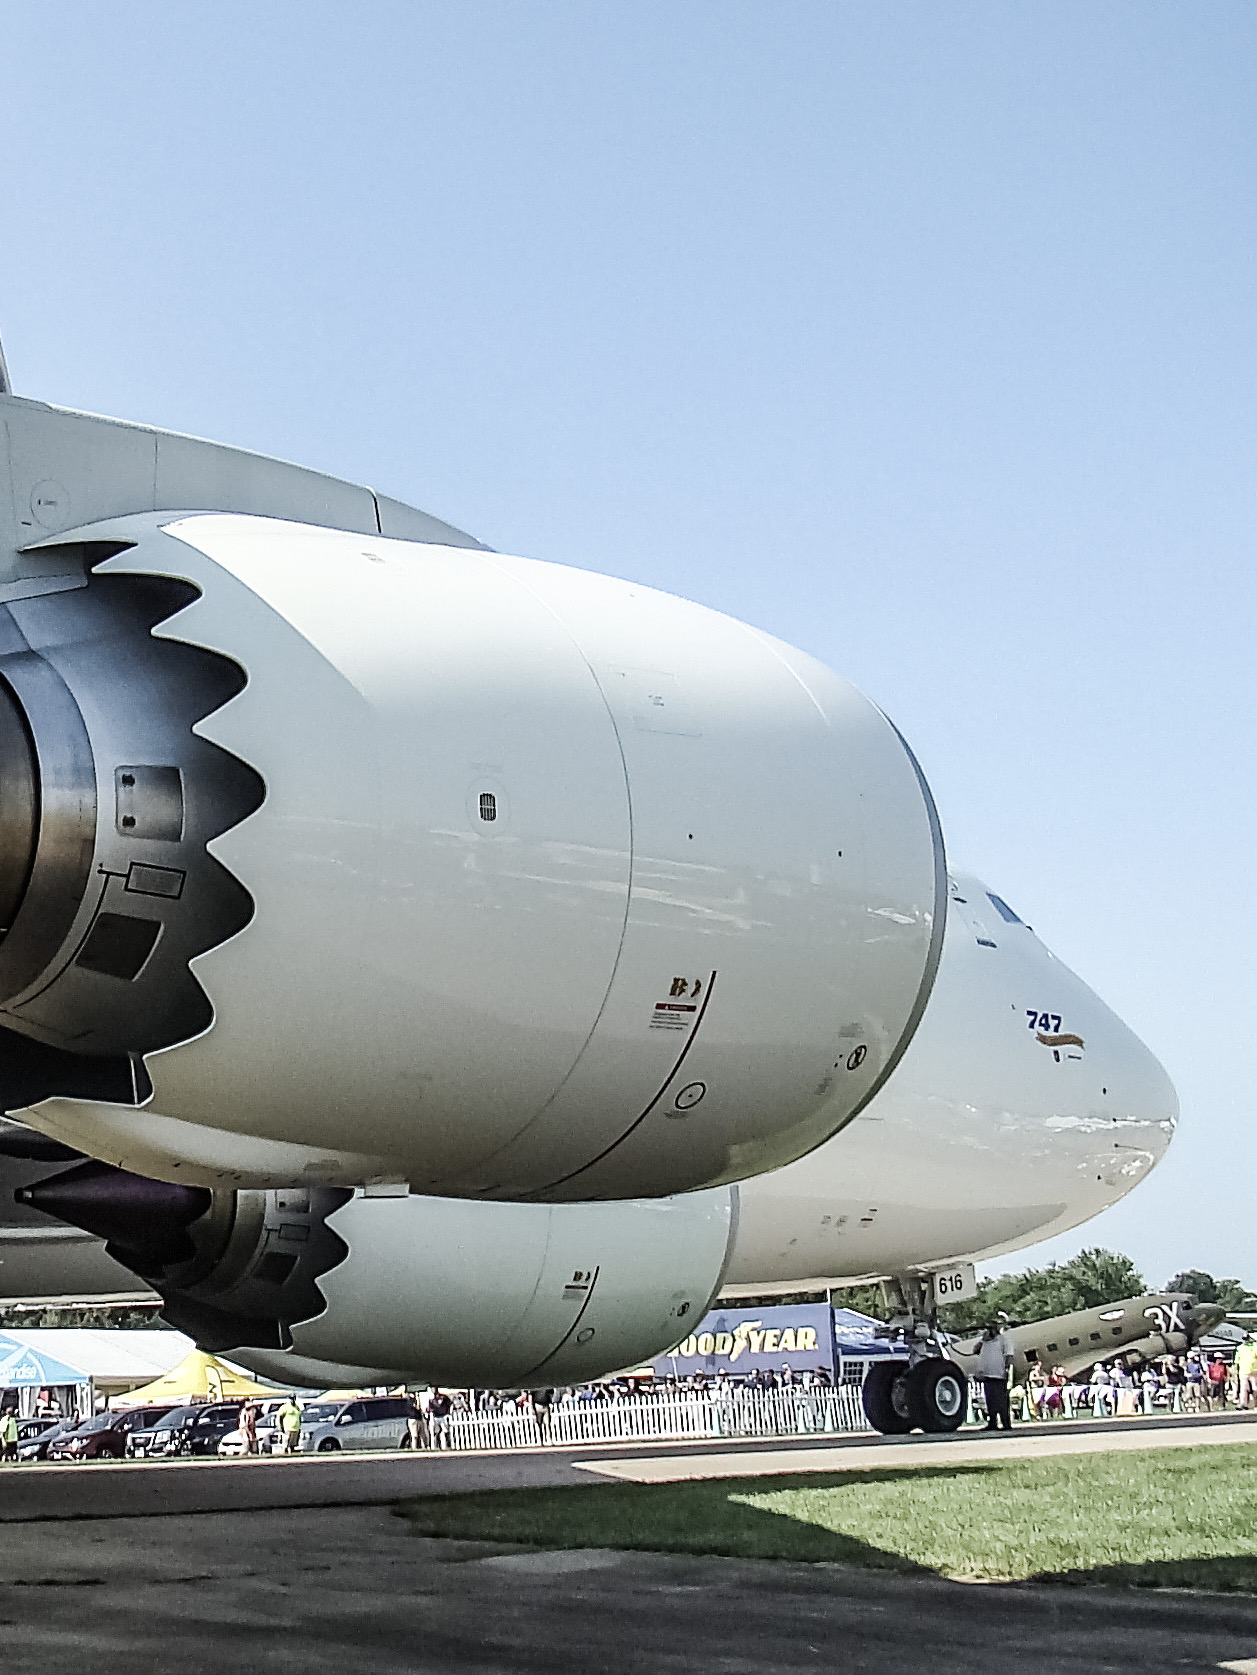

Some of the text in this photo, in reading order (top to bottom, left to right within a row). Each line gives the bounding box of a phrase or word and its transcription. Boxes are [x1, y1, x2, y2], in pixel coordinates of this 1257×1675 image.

[1026, 1010, 1062, 1033] 747
[939, 1273, 963, 1294] 616
[1143, 1301, 1186, 1334] 3X
